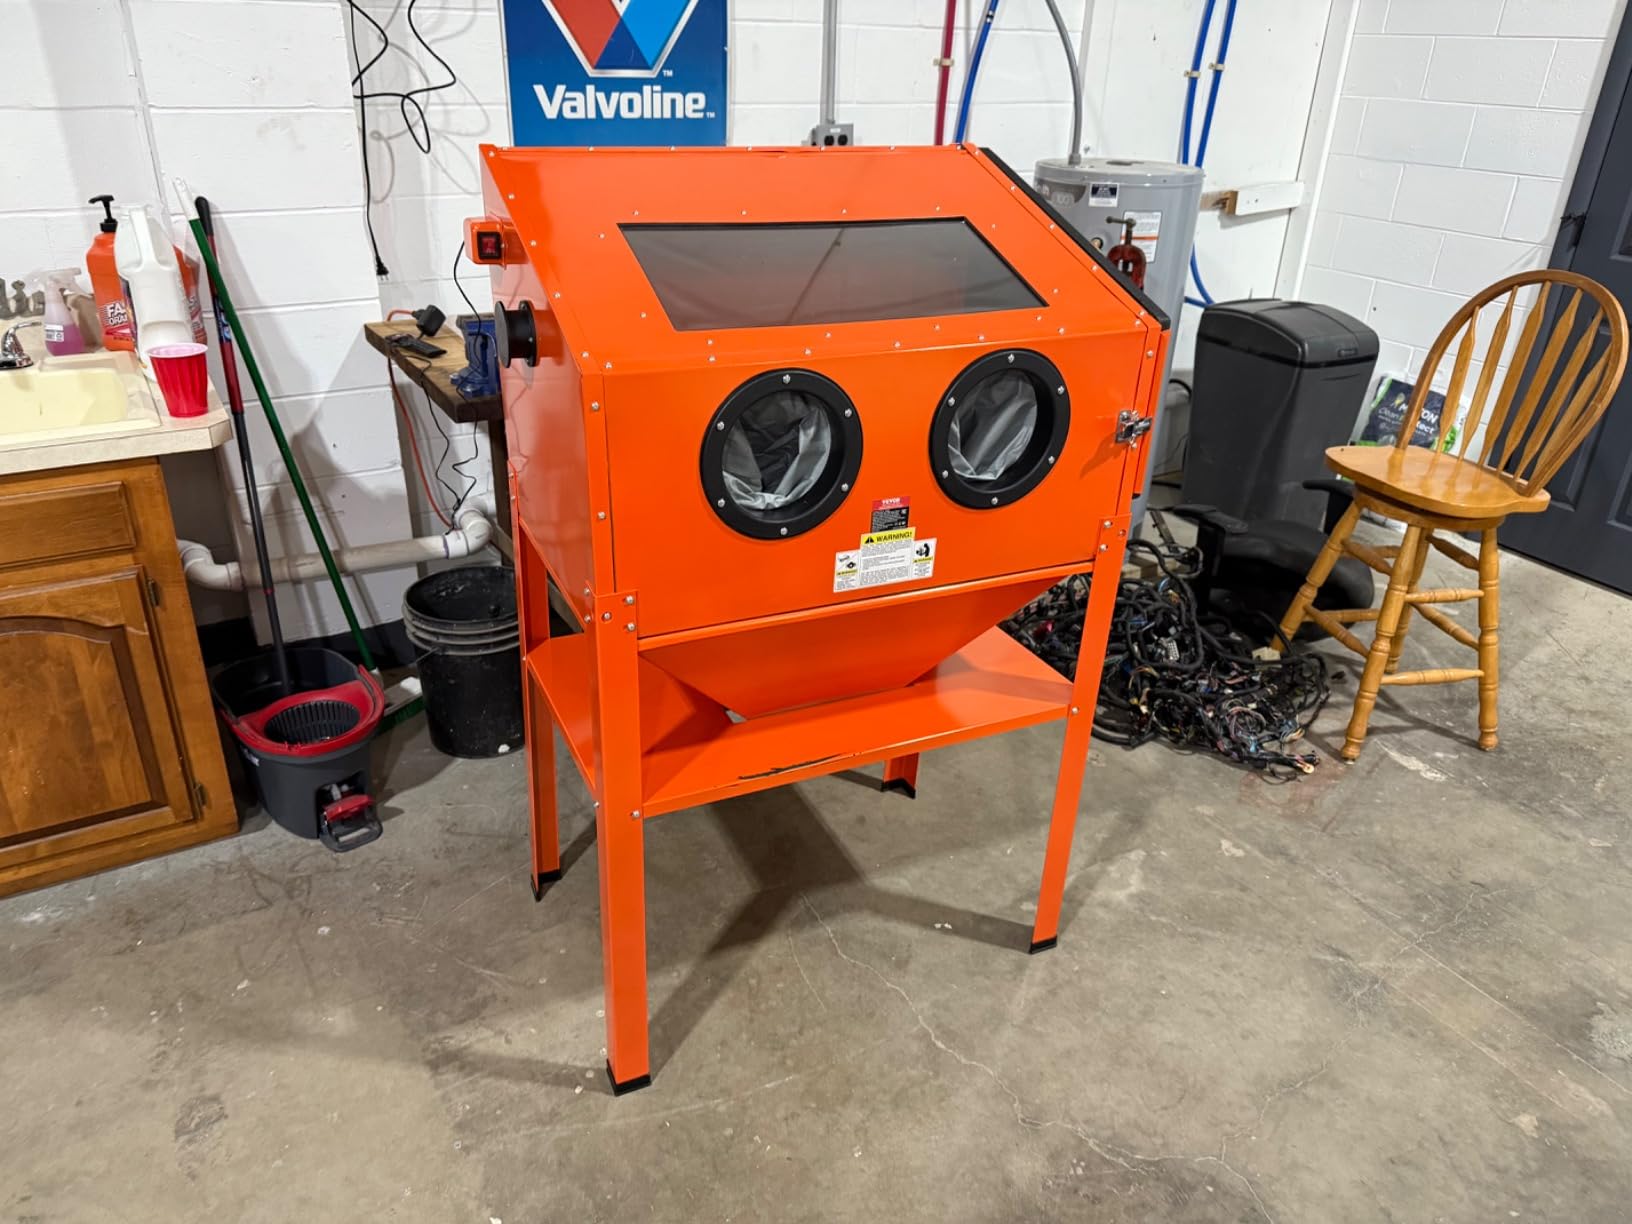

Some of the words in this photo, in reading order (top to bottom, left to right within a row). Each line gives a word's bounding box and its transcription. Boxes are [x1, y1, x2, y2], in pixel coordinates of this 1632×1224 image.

[532, 84, 706, 120] Valvoline
[106, 301, 126, 318] FA
[876, 531, 912, 543] WARNING!
